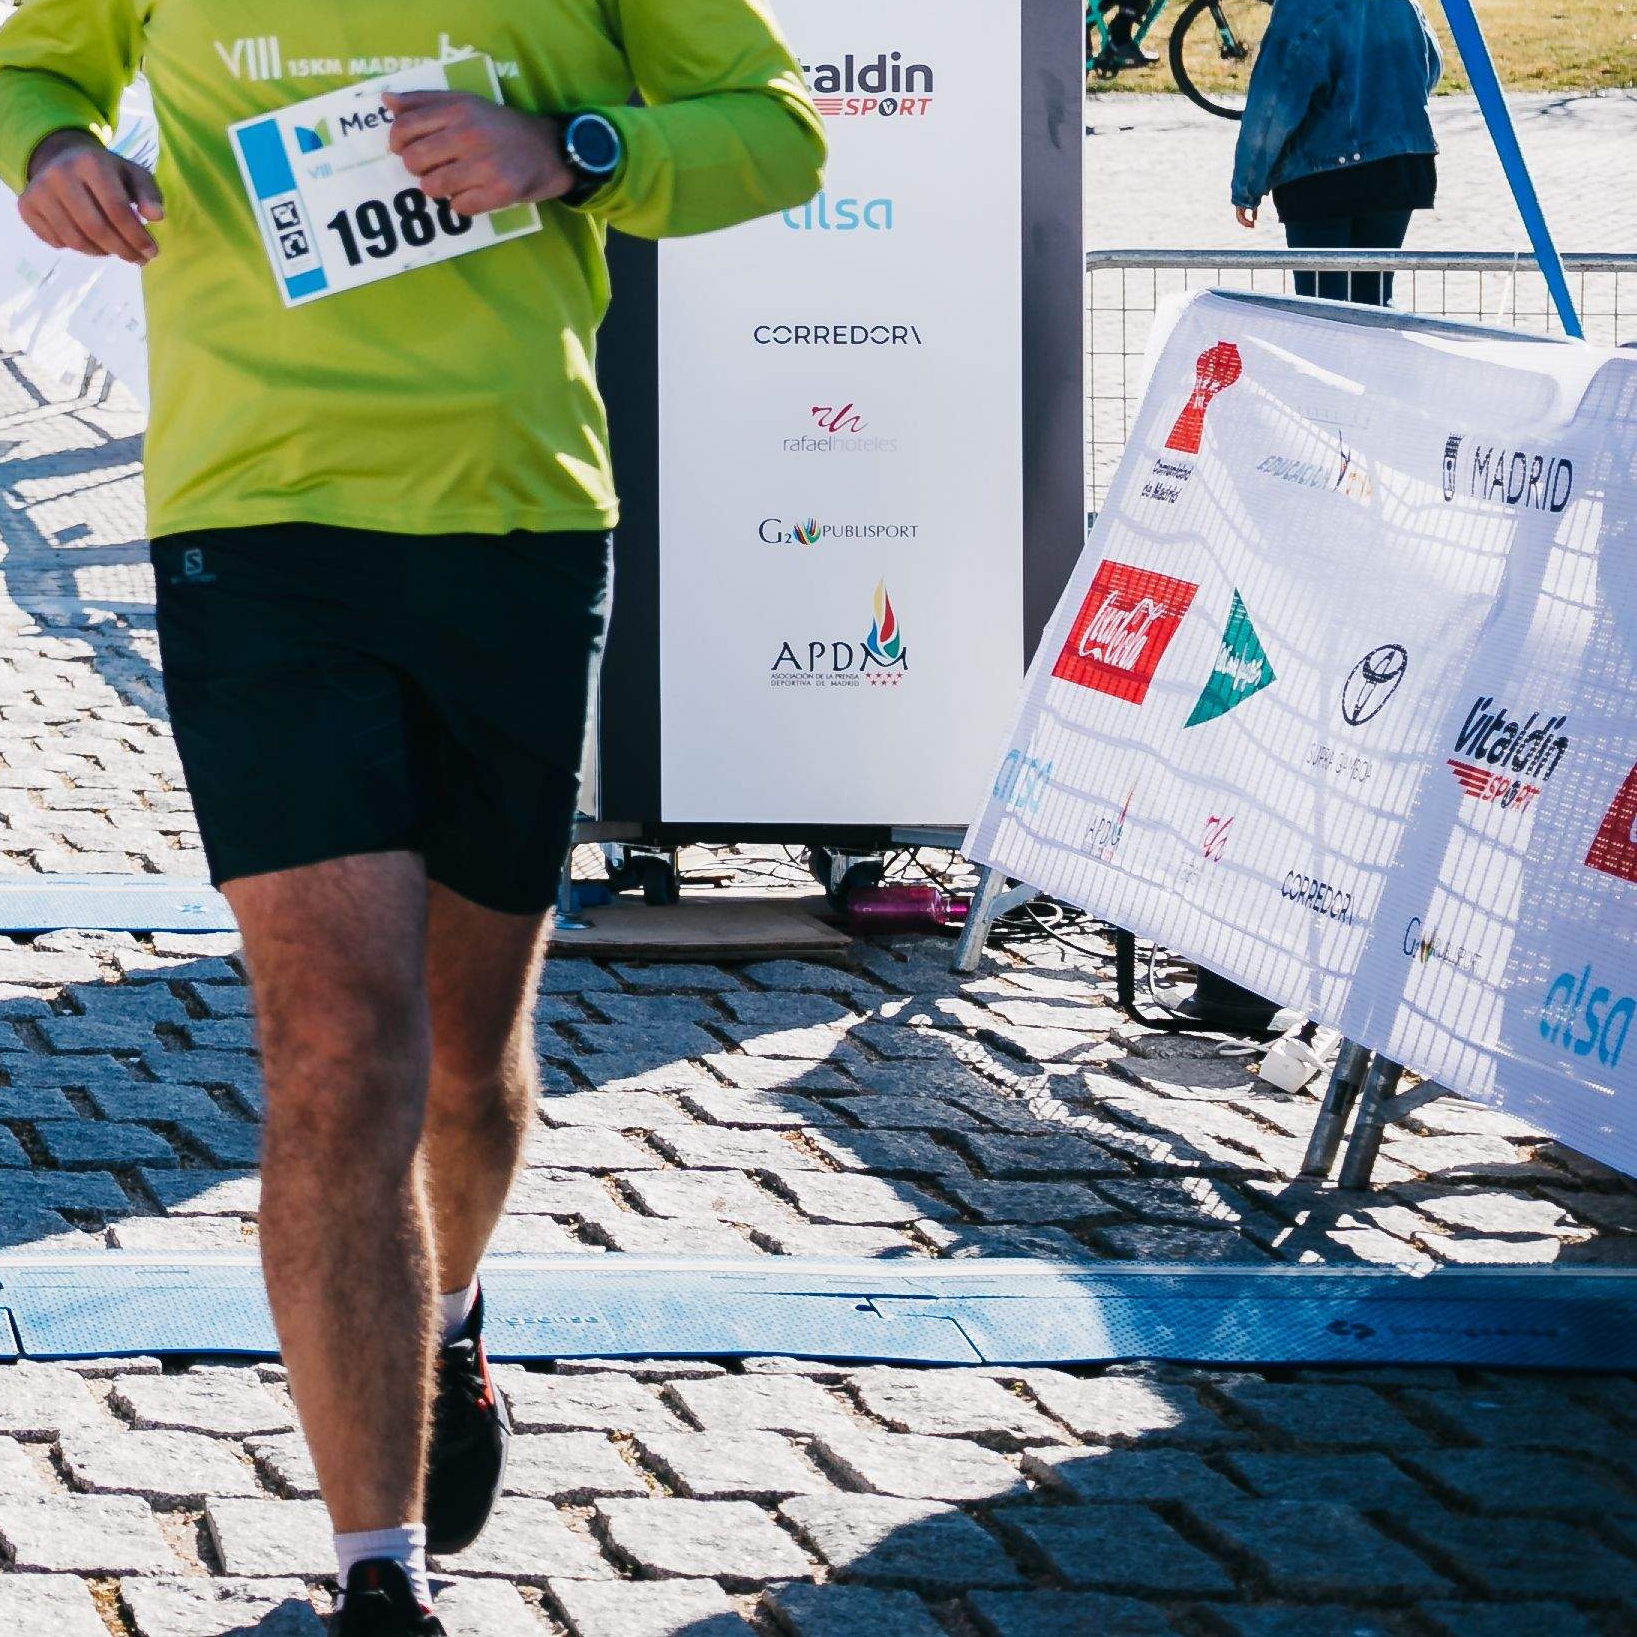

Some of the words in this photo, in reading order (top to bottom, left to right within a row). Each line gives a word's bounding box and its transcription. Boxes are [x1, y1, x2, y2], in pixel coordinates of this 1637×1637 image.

[213, 35, 283, 82] VIII
[287, 59, 344, 79] 15KM
[798, 51, 934, 94] aldin
[843, 97, 934, 117] SPORT
[1470, 444, 1574, 513] MADRID
[822, 523, 919, 539] PUBLISPORT
[770, 640, 909, 672] APDM
[815, 672, 824, 680] DE
[825, 672, 834, 680] LA
[835, 672, 860, 680] PRENSA
[770, 679, 812, 687] DEPORTIVA
[816, 679, 825, 687] DE
[830, 679, 860, 687] MADRID
[1453, 694, 1570, 782] Vitaldin
[1482, 773, 1542, 814] SPORT
[1538, 964, 1636, 1070] alsa
